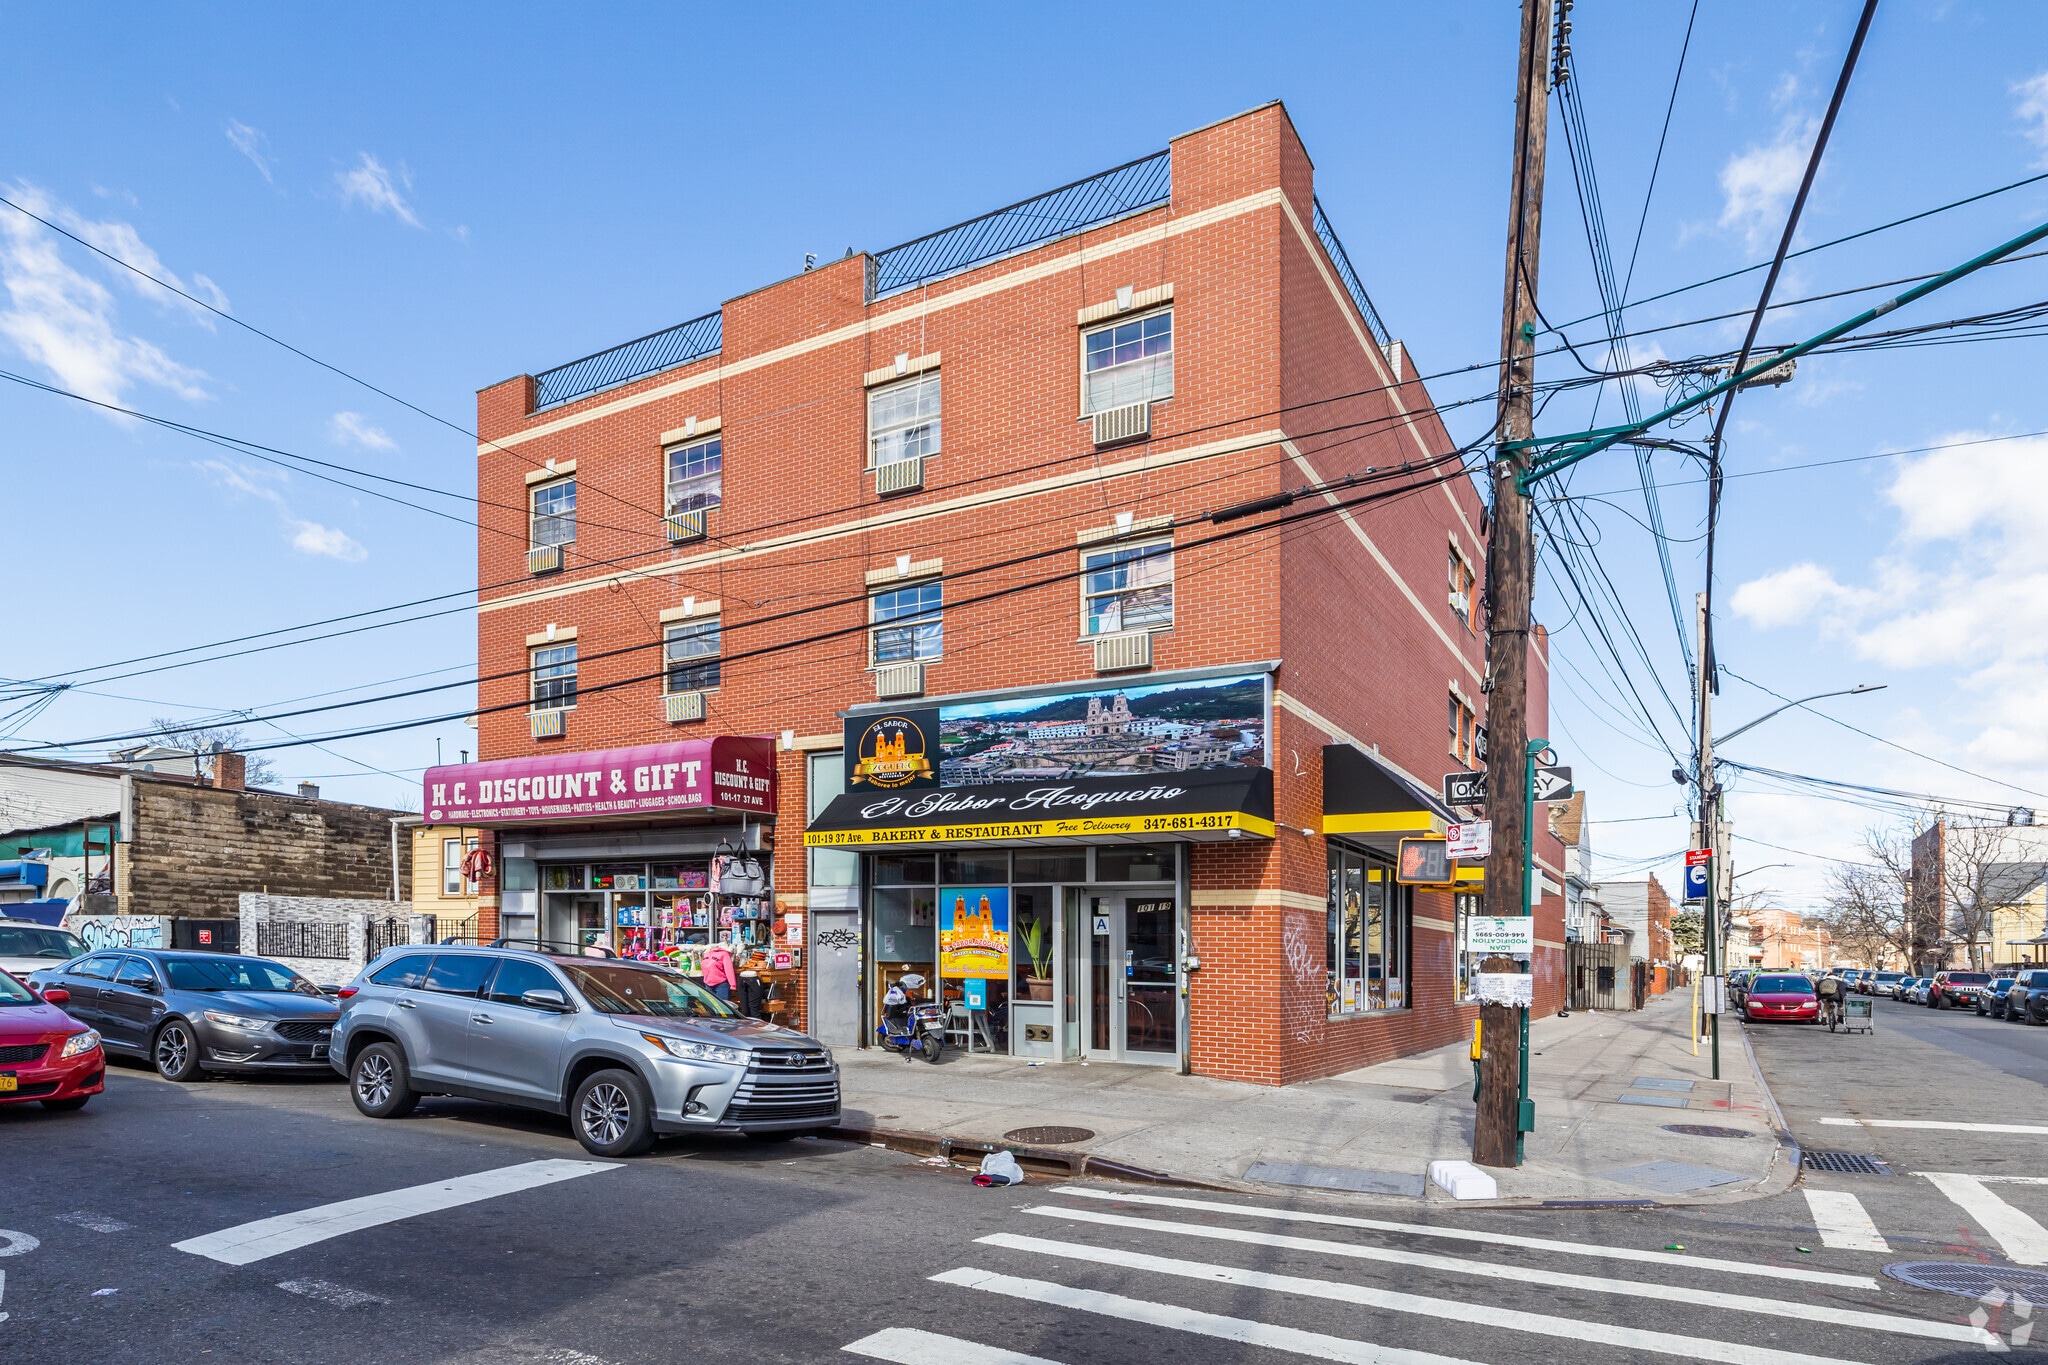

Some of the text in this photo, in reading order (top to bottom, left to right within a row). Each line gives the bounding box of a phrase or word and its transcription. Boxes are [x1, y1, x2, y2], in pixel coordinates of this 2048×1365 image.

[873, 720, 908, 732] EL SABOR
[735, 758, 749, 773] H.C.
[431, 760, 702, 806] H.C. DISCOUNT & GIFT
[714, 771, 770, 793] DISCOUNT & GIFT
[1534, 777, 1554, 791] AY
[471, 808, 499, 818] ELECTRONICS
[500, 806, 526, 817] STATIONERY
[528, 805, 540, 815] TOYS
[541, 803, 572, 815] HOUSEWARES
[573, 802, 593, 813] PARTIES
[594, 800, 613, 811] HEALTH
[613, 800, 618, 811] &
[617, 798, 637, 810] BEAUTY
[638, 796, 665, 808] LUGGAGES
[667, 794, 687, 806] SCHOOL
[688, 792, 702, 803] BAGS
[720, 791, 764, 806] 101-17 37 AVE
[860, 785, 1187, 819] El Sabor Azogueño
[807, 834, 834, 844] 101-19
[835, 833, 845, 843] 37
[847, 832, 864, 842] Ave.
[872, 830, 926, 842] BAKERY
[930, 829, 941, 839] &
[945, 824, 1043, 839] RESTAURANT
[1056, 821, 1078, 833] Free
[1143, 815, 1234, 830] 347-681-4317
[1136, 902, 1172, 912] 101 19
[1096, 918, 1107, 930] A
[952, 939, 973, 949] SABOR
